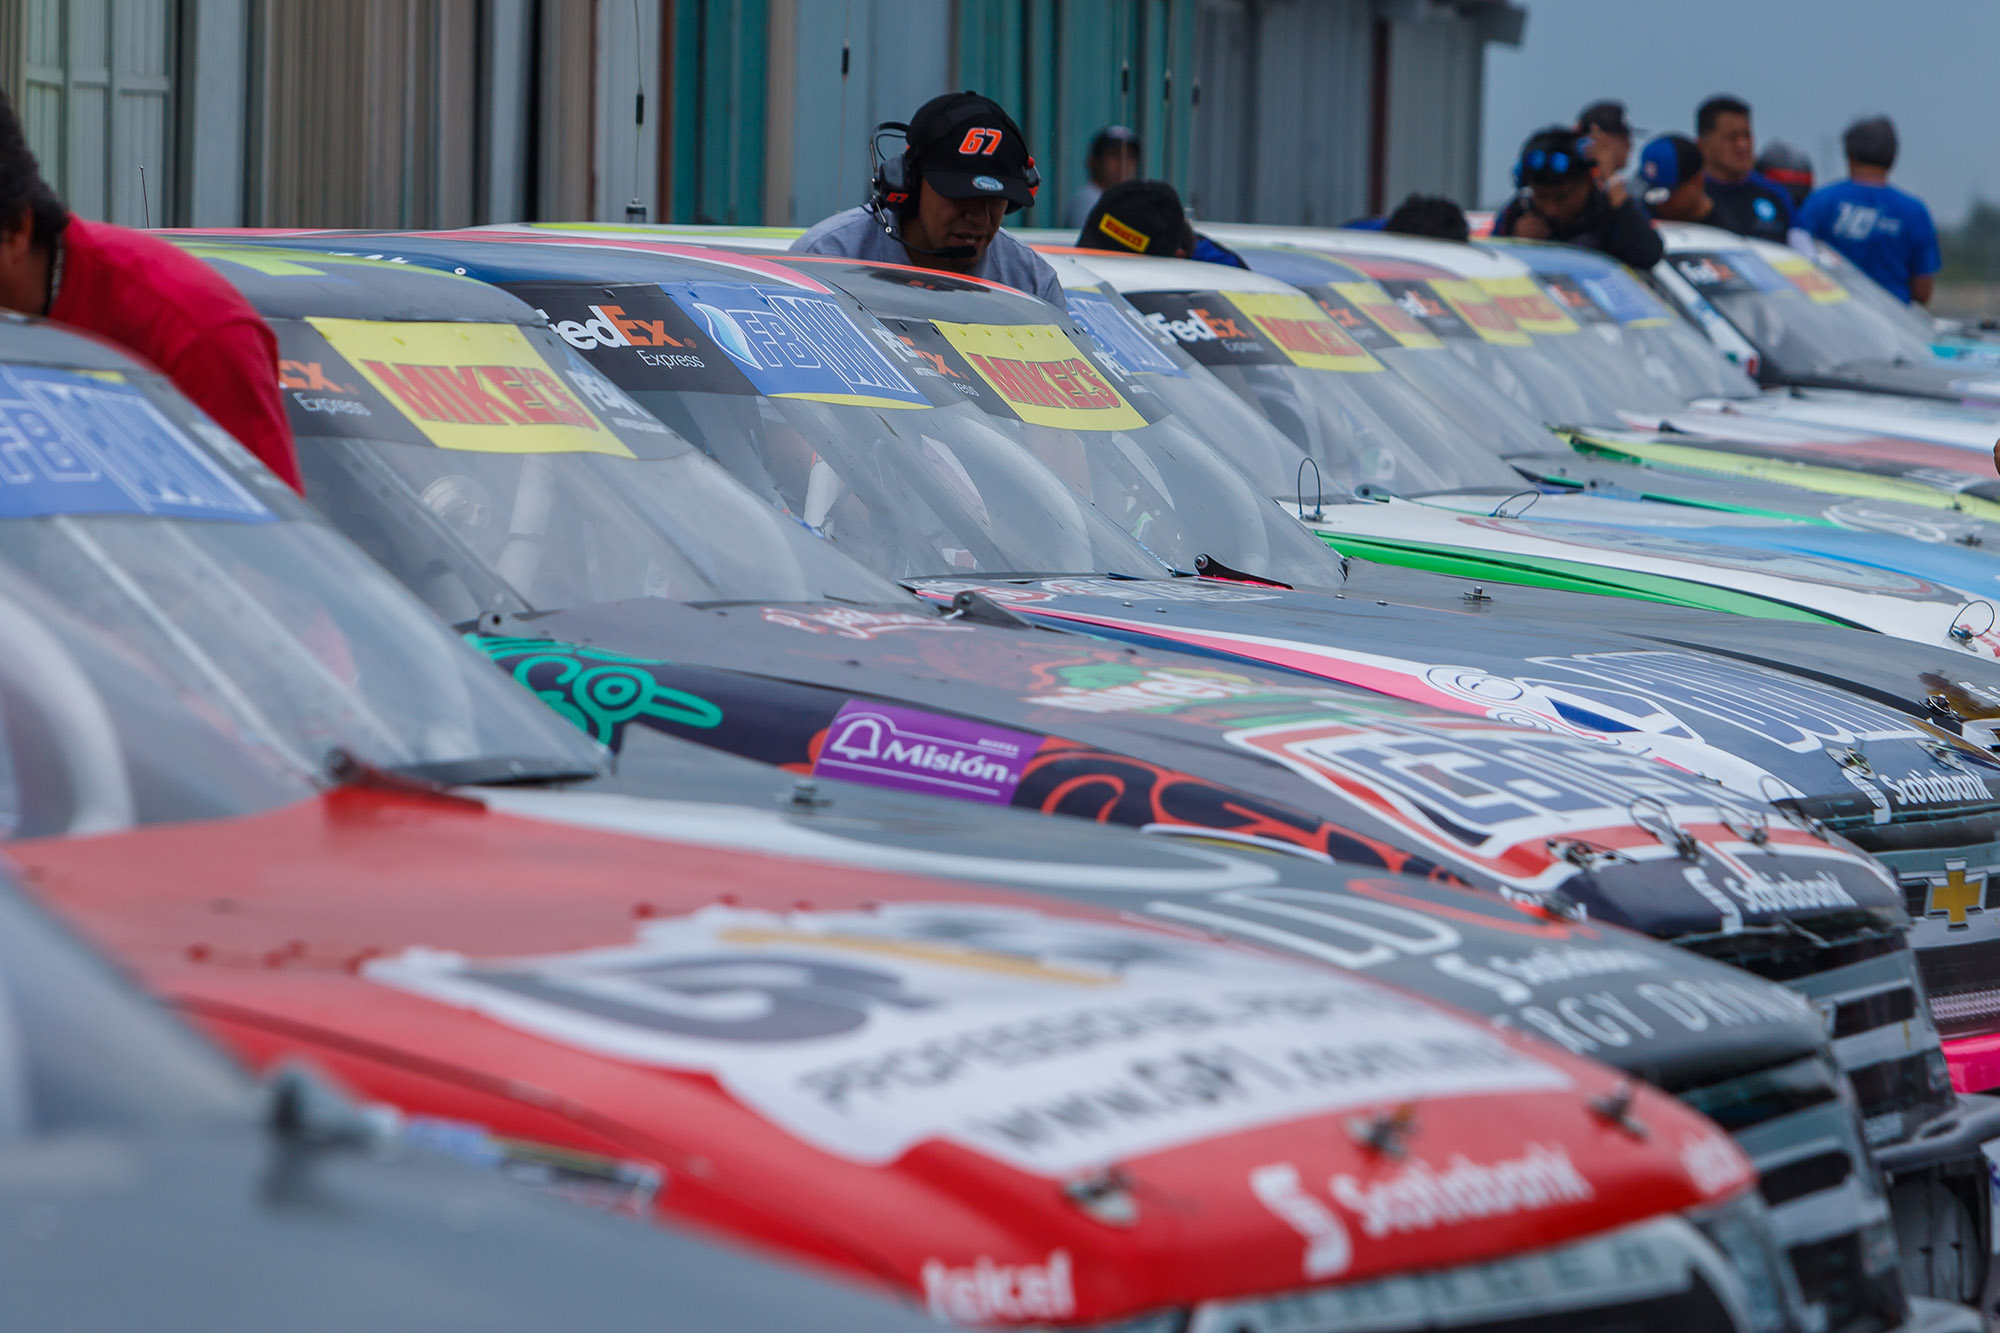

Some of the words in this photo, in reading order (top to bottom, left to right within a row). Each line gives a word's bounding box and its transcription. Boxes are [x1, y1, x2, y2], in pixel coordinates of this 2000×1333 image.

[958, 127, 1002, 155] 67
[636, 350, 705, 370] Express
[881, 740, 1010, 784] Misión
[1878, 767, 1995, 807] Scotiabank
